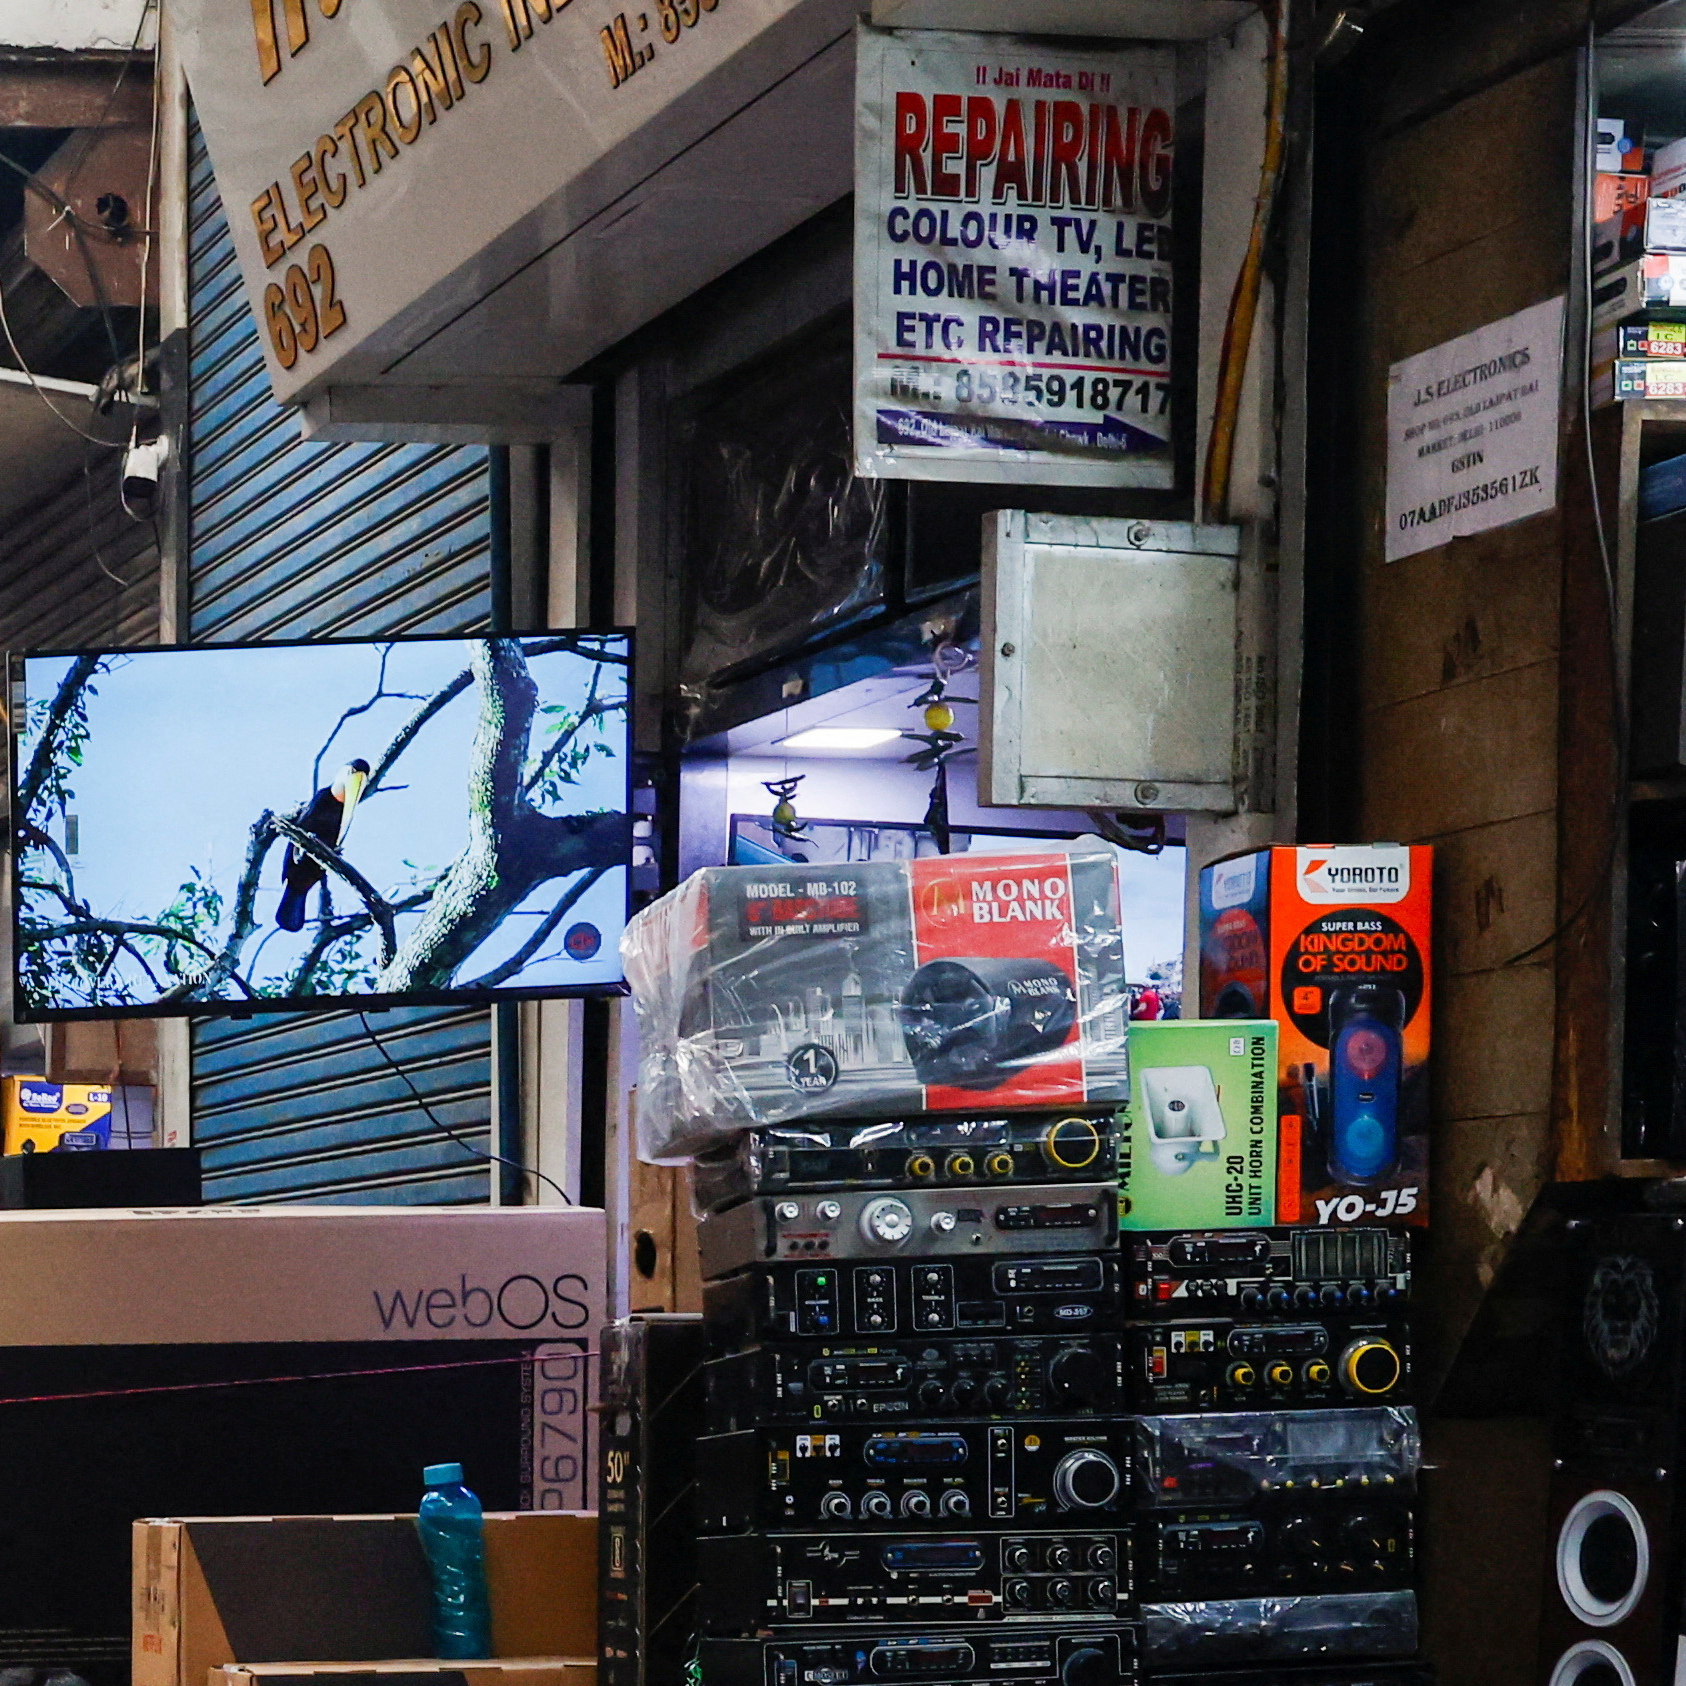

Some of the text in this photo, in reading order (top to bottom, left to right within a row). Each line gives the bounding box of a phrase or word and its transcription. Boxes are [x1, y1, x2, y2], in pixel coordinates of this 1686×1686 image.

[993, 67, 1098, 90] Jai Mata Di
[250, 1, 491, 269] ELECTRONIC
[893, 90, 1173, 218] REPAIRING
[887, 206, 1102, 264] COLOUR TV,
[893, 259, 1171, 314] HOME THEATER
[263, 244, 346, 370] 692
[896, 311, 1168, 365] ETC REPAIRING
[1437, 347, 1531, 398] ELECTRONICS
[970, 877, 1067, 902] MONO
[1327, 866, 1400, 887] YOROTO
[746, 881, 795, 899] MODEL
[972, 900, 1064, 924] BLANK
[749, 925, 773, 937] WITH
[1321, 920, 1383, 933] SUPER BASS
[1299, 932, 1408, 953] KINGDOM
[1298, 953, 1409, 974] OF SOUND
[1023, 975, 1060, 989] MONO
[803, 1048, 817, 1074] 1
[1248, 1036, 1266, 1216] UNIT HORN COMBINATION
[1314, 1186, 1420, 1225] YO-J5
[373, 1273, 589, 1332] webOS
